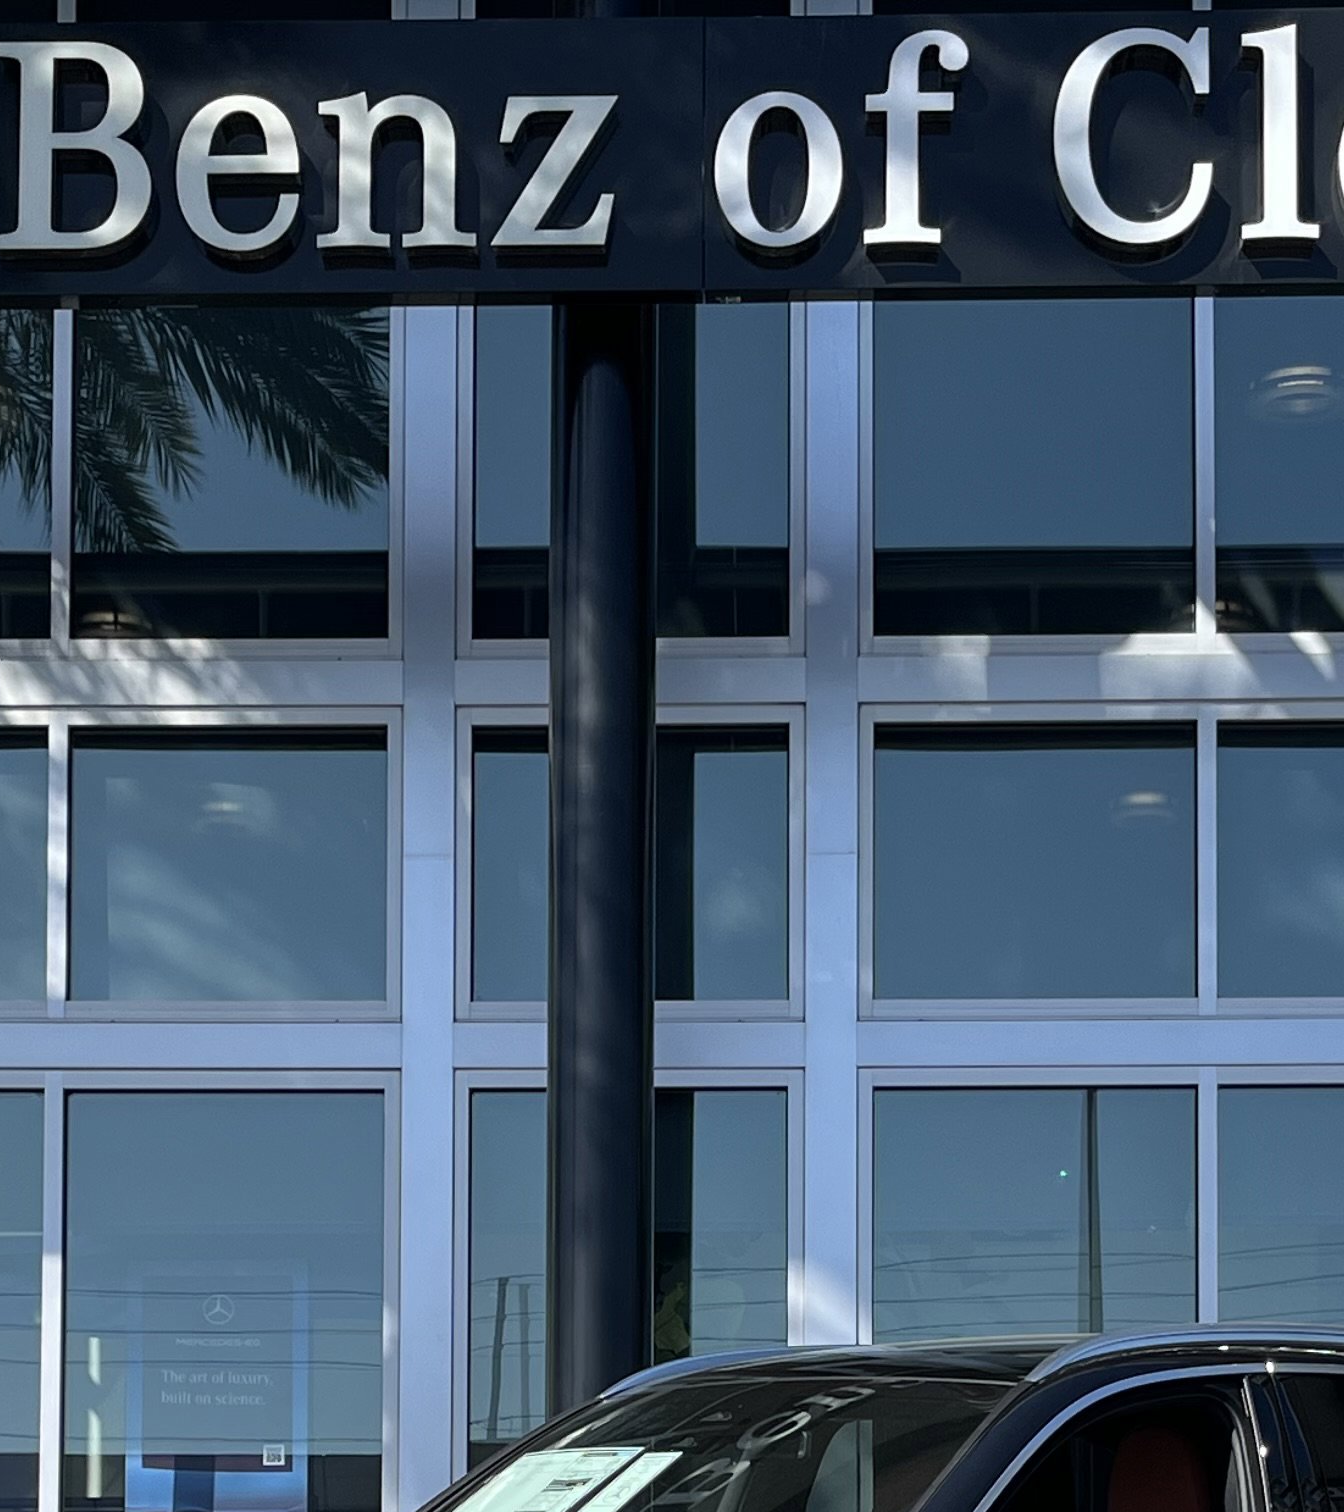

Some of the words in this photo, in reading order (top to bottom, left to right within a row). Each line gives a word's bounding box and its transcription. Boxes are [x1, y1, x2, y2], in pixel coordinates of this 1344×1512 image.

[714, 29, 970, 247] of
[160, 1369, 186, 1384] The
[188, 1372, 209, 1385] art
[211, 1370, 225, 1384] of
[160, 1389, 192, 1405] built
[194, 1393, 212, 1405] on
